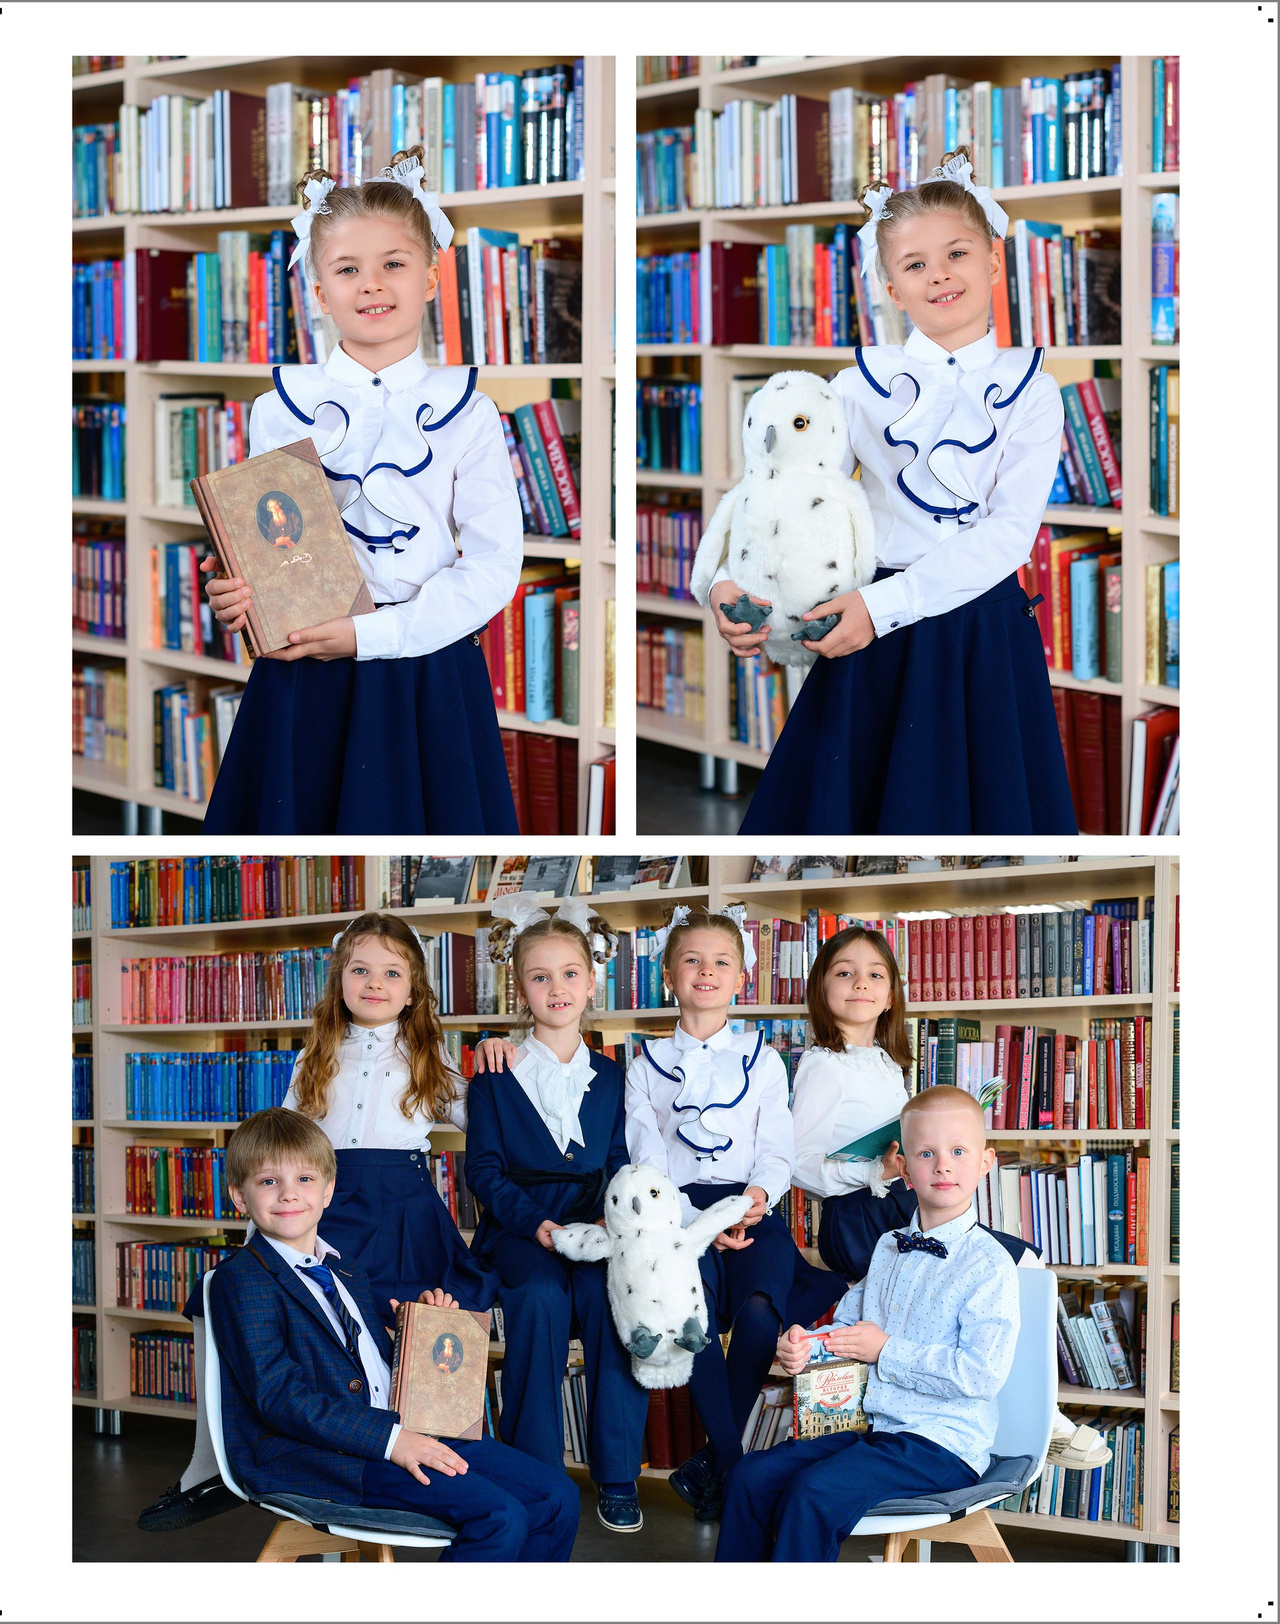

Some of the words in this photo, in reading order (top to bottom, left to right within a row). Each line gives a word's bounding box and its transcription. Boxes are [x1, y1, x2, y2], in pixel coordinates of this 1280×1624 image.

[1090, 415, 1117, 478] МОСКВА
[548, 439, 576, 507] МОСКВА
[957, 1026, 980, 1041] МОСКВА
[1022, 1054, 1032, 1079] БИТВА
[994, 1088, 1004, 1117] Марша
[1019, 1080, 1030, 1128] МОСКОВСКАЯ
[822, 1385, 848, 1393] ИСТОРИЯ
